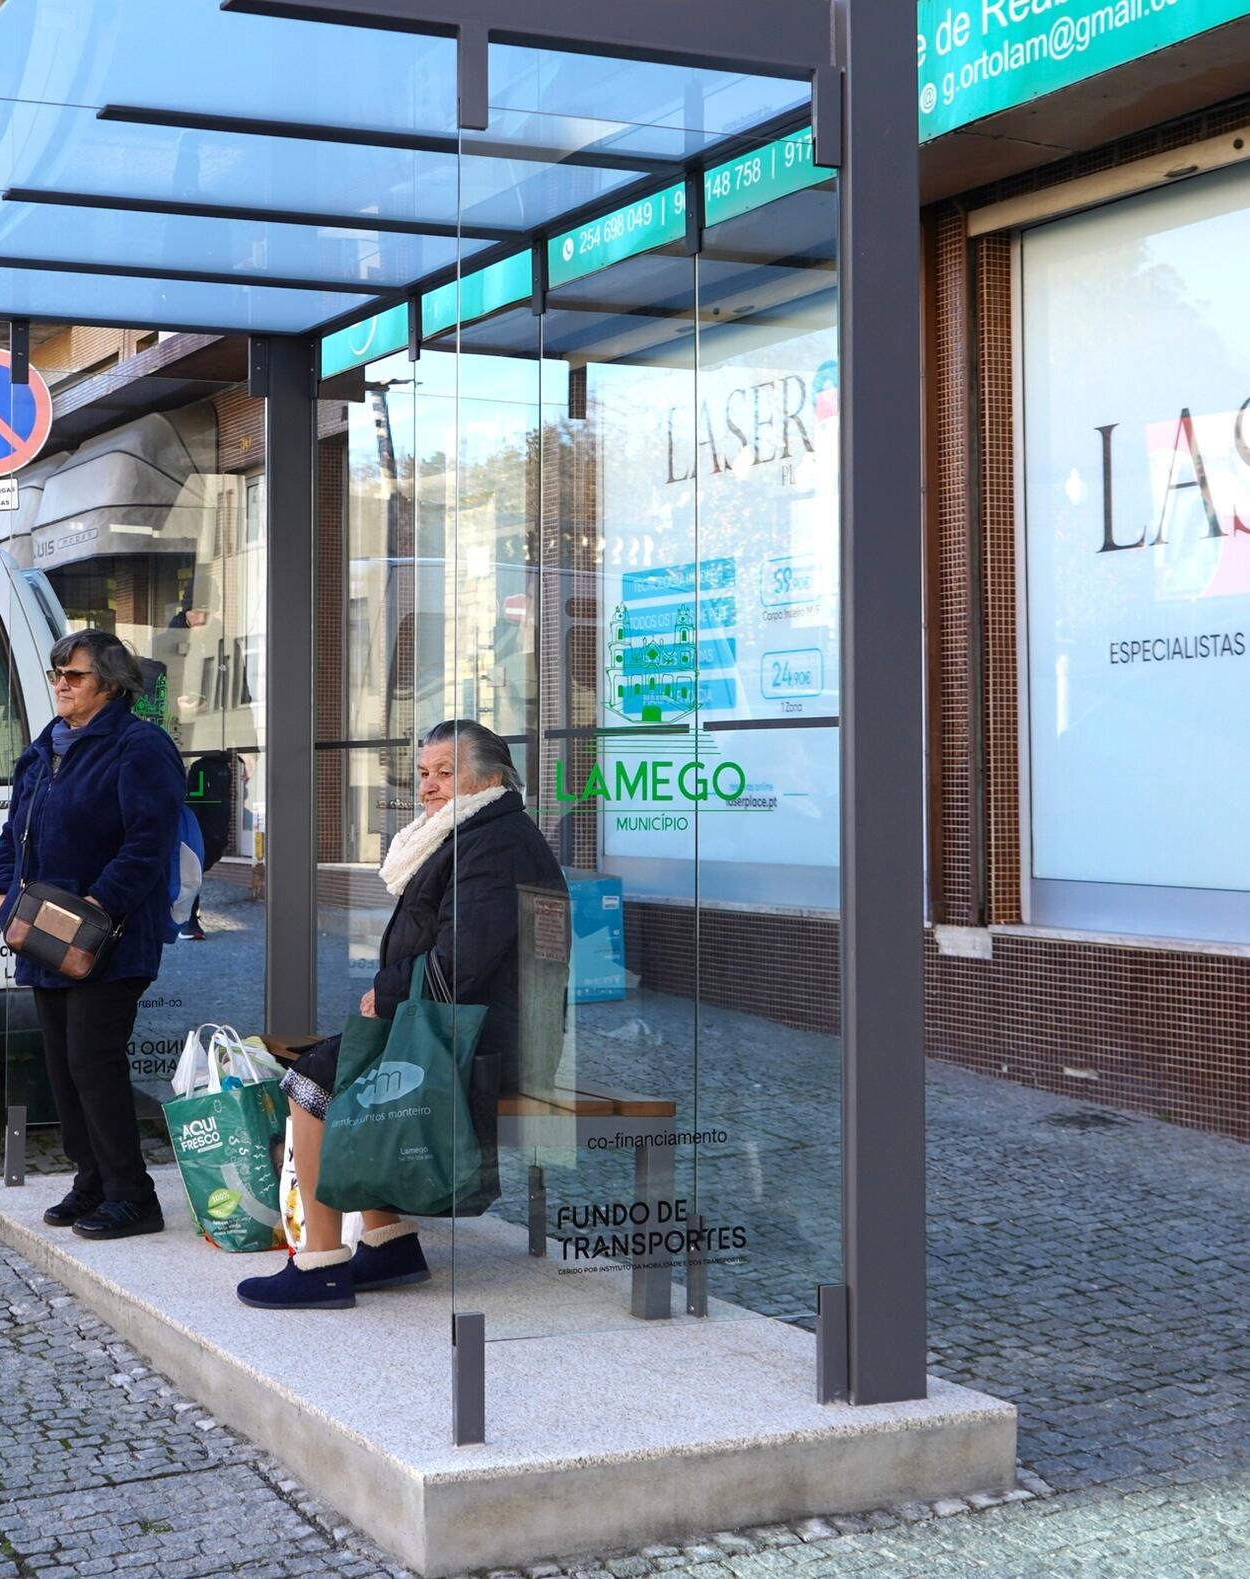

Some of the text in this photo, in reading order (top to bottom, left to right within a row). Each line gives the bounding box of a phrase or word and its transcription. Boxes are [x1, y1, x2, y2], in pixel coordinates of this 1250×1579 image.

[935, 8, 971, 57] de
[579, 226, 600, 254] 254
[603, 215, 625, 243] 698
[627, 199, 653, 231] 049
[734, 157, 762, 191] 758
[665, 375, 815, 485] LASER
[1110, 632, 1246, 665] ESPECIALISTAS
[556, 761, 746, 801] LAMEGO
[616, 813, 689, 831] MUNICÍPIO
[388, 1106, 431, 1119] monteiro
[181, 1131, 221, 1152] FRESCO
[182, 1116, 218, 1140] AQUI
[588, 1129, 728, 1150] co-financiamento
[400, 1146, 429, 1156] Lamego
[558, 1199, 688, 1230] FUNDO DE
[558, 1226, 747, 1260] TRANSPORTES
[584, 1266, 598, 1274] POR
[599, 1264, 631, 1272] INSTITUTO
